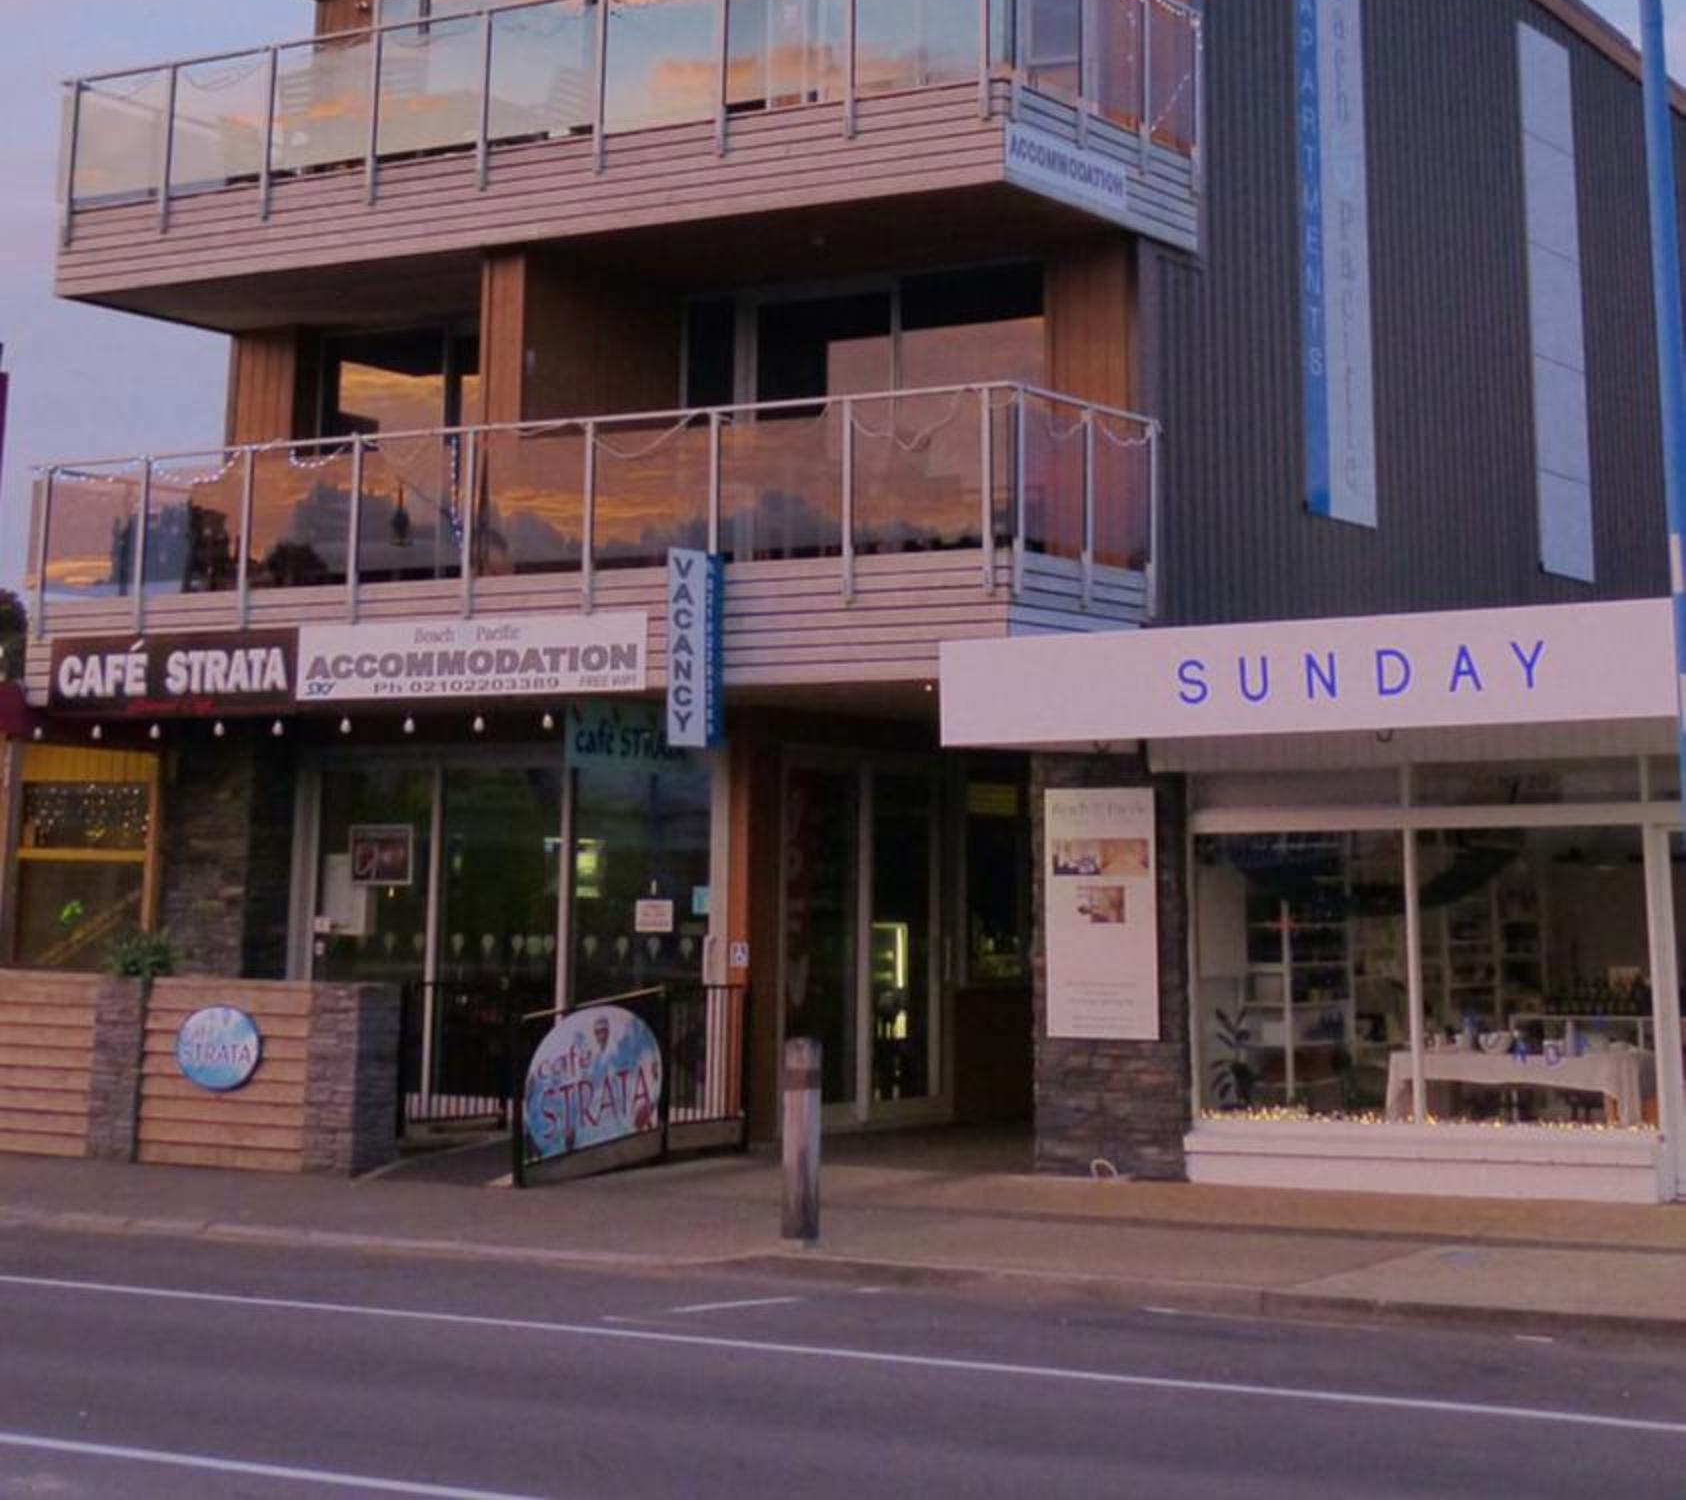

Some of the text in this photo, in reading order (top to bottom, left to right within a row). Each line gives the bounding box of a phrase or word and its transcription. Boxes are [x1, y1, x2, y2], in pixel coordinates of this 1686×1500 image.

[1009, 132, 1123, 197] ACCOMMODATION
[58, 638, 288, 698] CAFÉ STRATA
[305, 644, 638, 681] ACCOMMODATION
[673, 556, 694, 733] VACANCY
[1176, 640, 1544, 704] SUNDAY
[540, 1064, 650, 1142] STRATA
